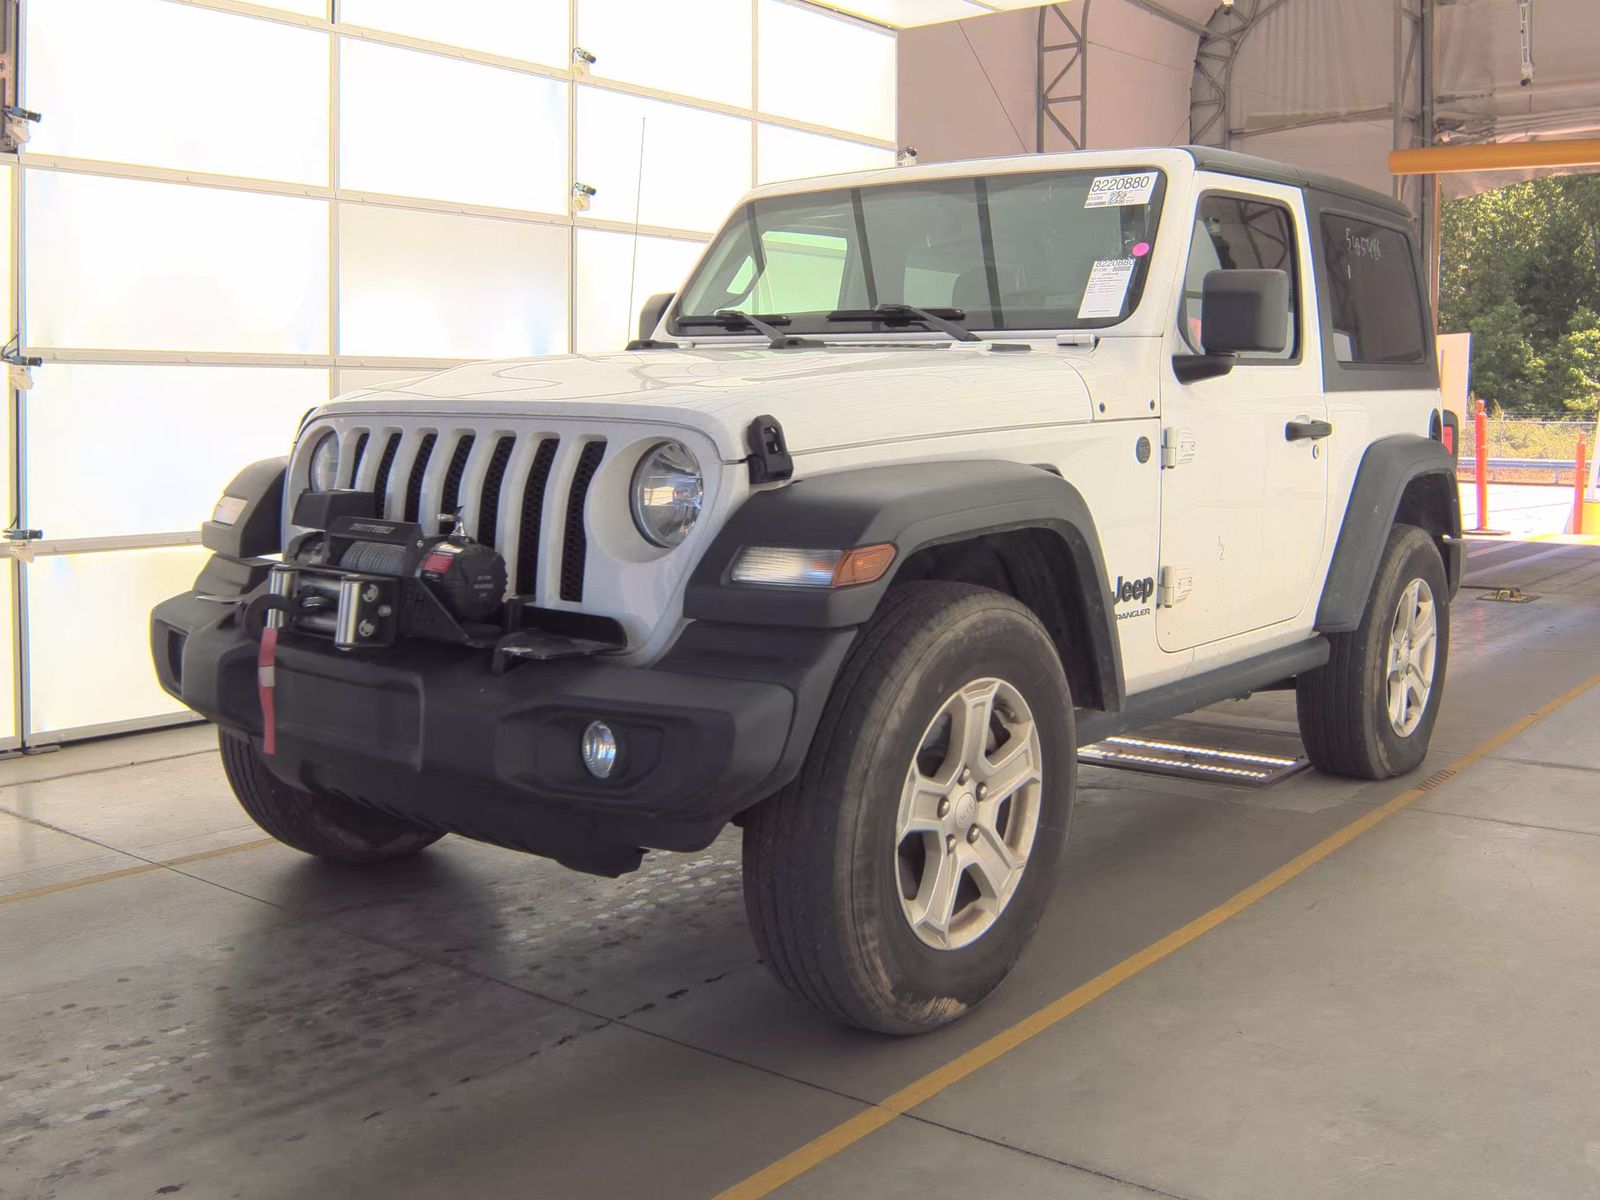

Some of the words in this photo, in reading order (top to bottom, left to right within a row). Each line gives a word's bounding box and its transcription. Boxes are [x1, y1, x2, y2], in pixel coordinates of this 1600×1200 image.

[1092, 176, 1150, 192] 8220880
[1114, 576, 1154, 604] Jeep
[1117, 608, 1151, 620] RANGLER
